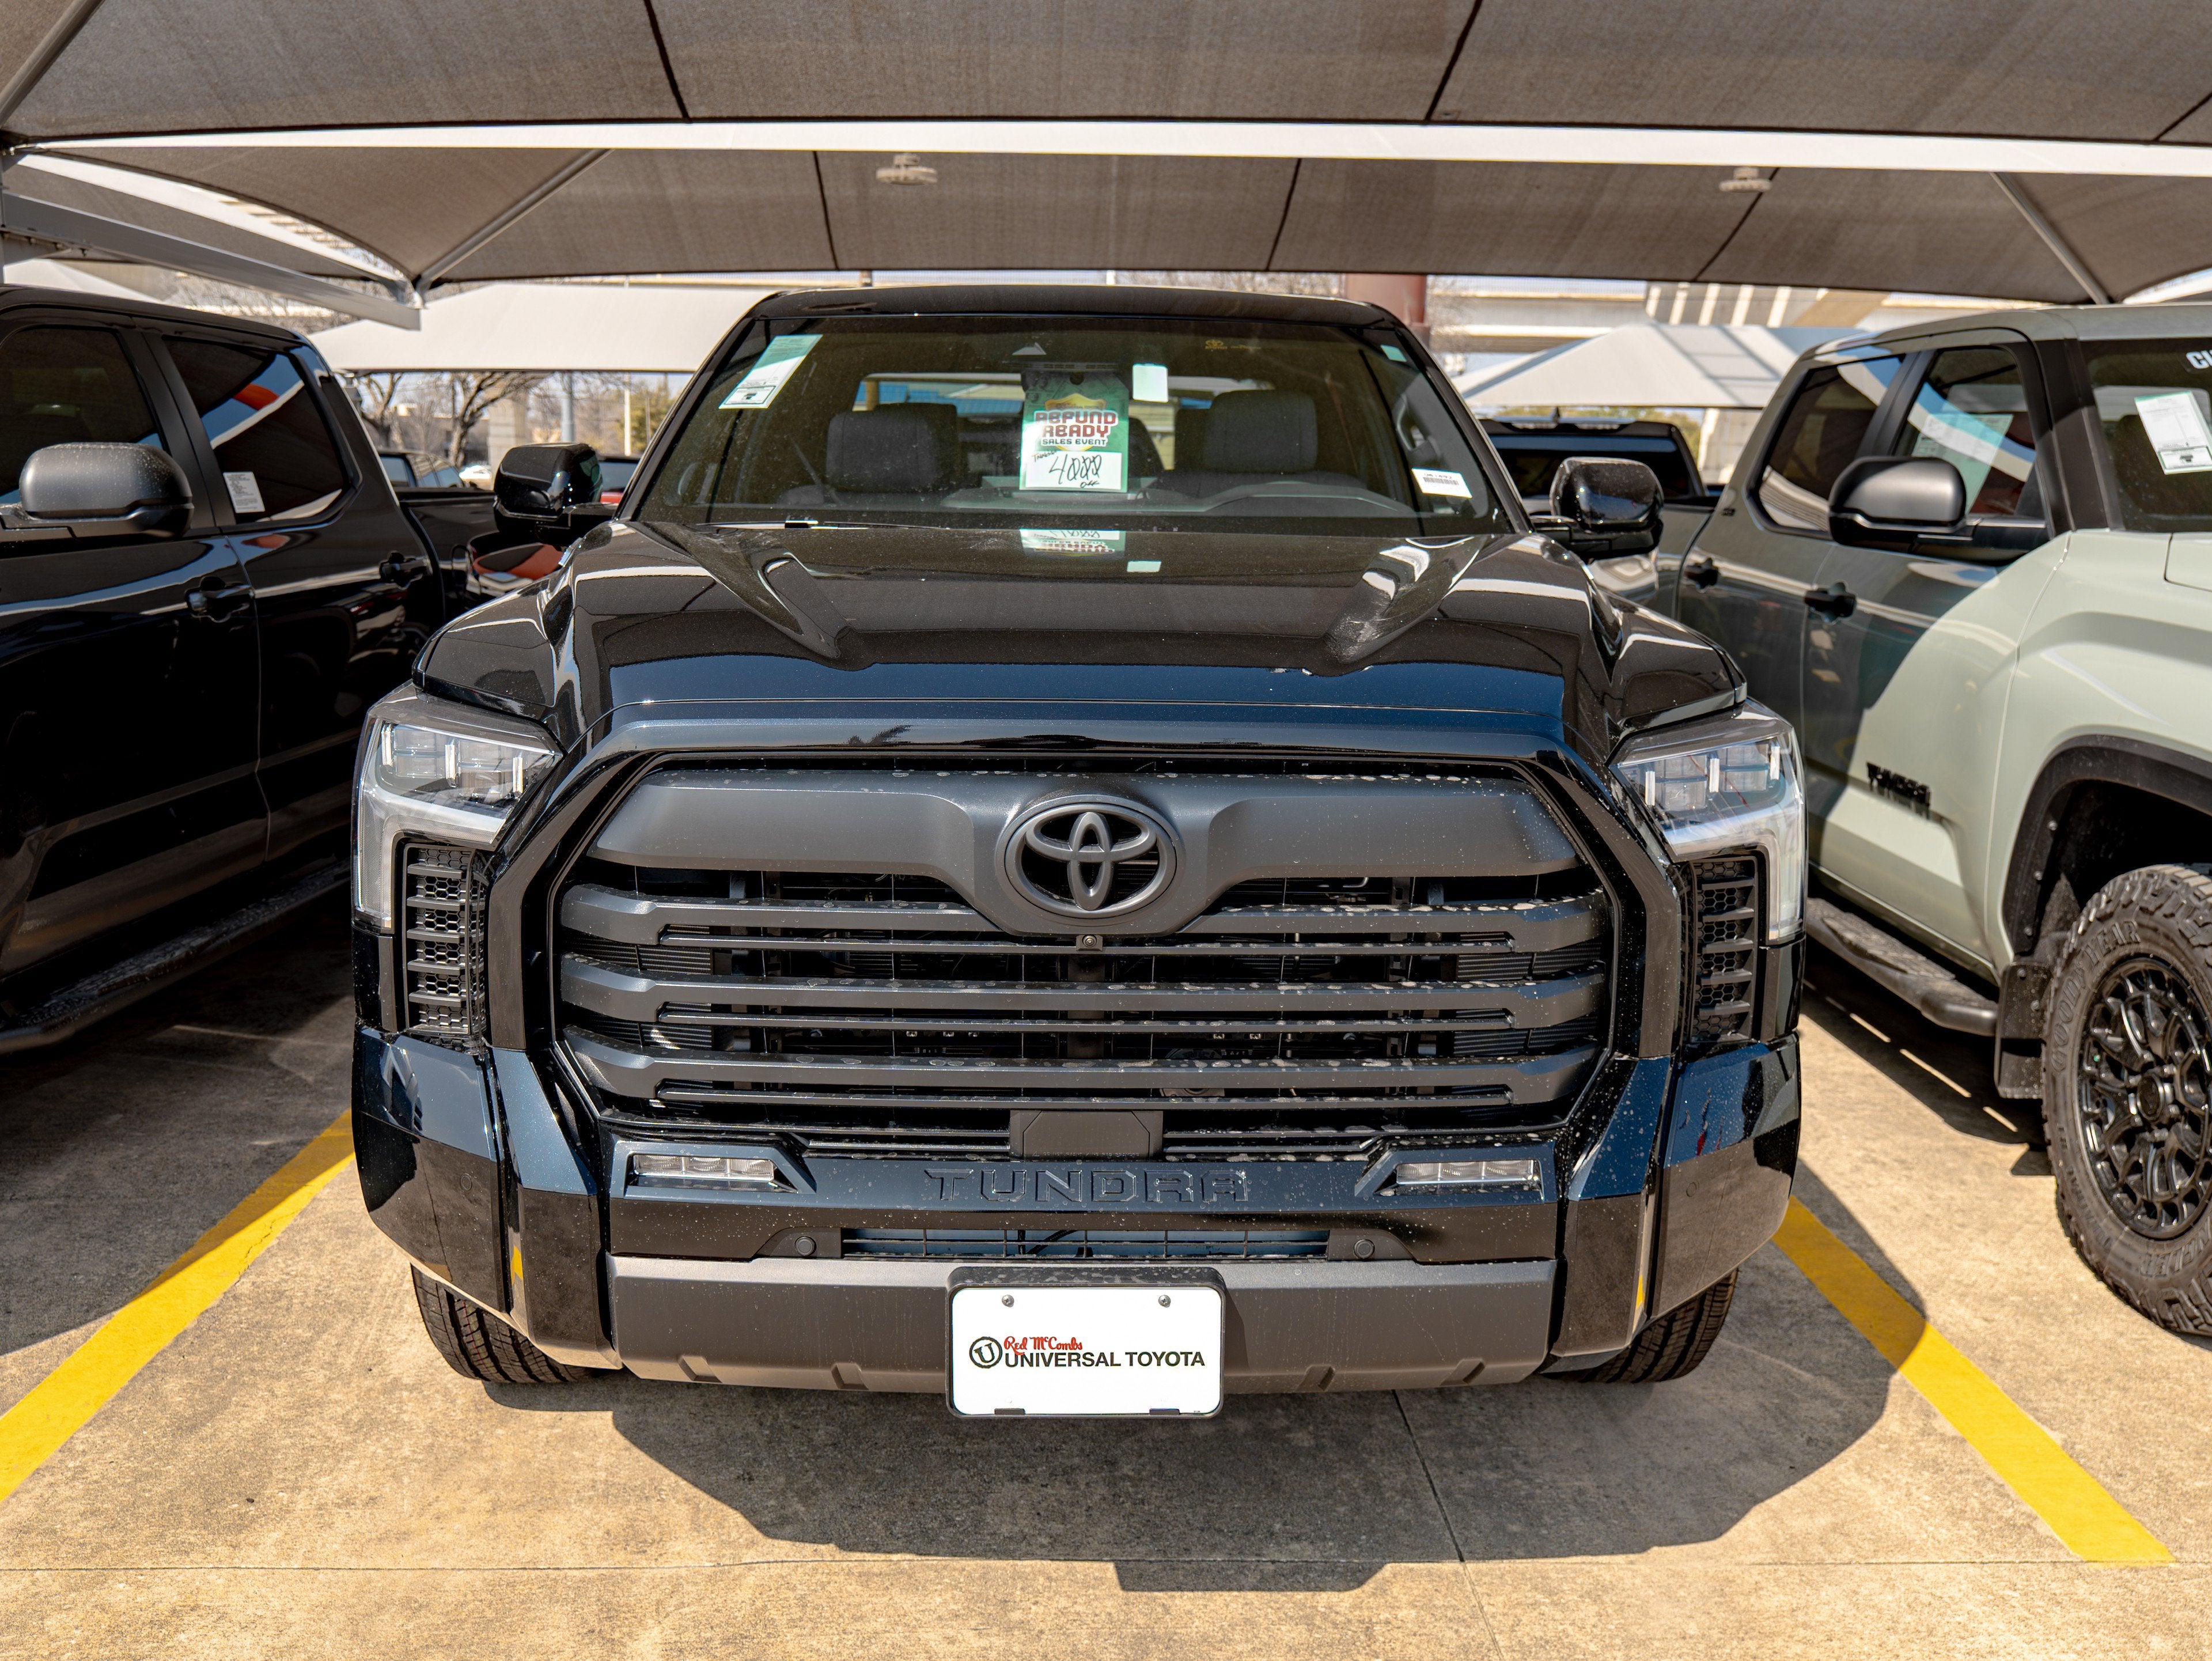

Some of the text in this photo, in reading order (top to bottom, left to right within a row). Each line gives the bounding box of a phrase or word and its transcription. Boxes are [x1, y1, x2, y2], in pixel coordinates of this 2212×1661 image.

[1035, 411, 1116, 424] REFUND
[1043, 425, 1109, 437] READY
[1048, 453, 1102, 485] 4000
[924, 1169, 1247, 1203] TUNDRA
[1004, 1336, 1083, 1355] Red McCombs
[1005, 1352, 1205, 1367] UNIVERSAL TOYOTA
